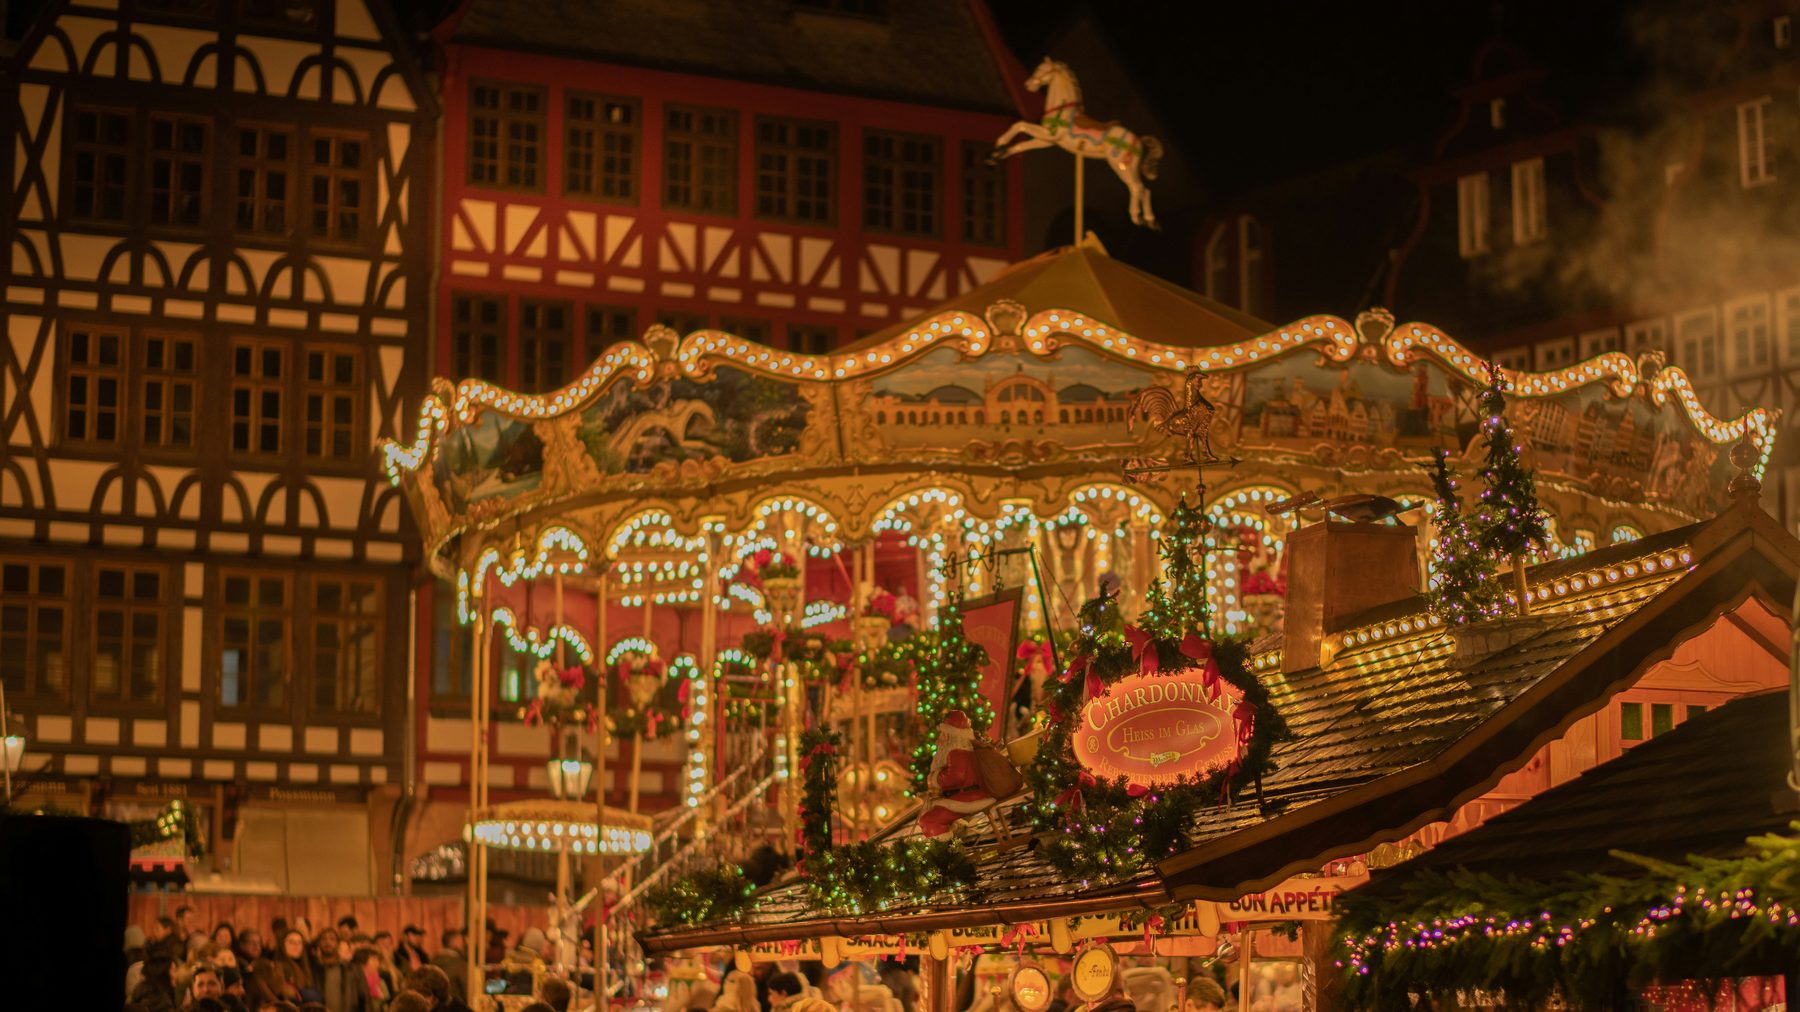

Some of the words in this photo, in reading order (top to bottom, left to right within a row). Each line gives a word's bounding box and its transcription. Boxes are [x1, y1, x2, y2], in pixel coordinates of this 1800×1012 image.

[1087, 682, 1238, 731] CHARDONNAY
[1123, 727, 1154, 743] HEISS
[1159, 727, 1171, 738] IM
[1175, 720, 1205, 737] GLAS
[1098, 755, 1191, 783] REBRTENREINR
[1229, 893, 1267, 912] BON
[1270, 885, 1339, 914] APPÉT
